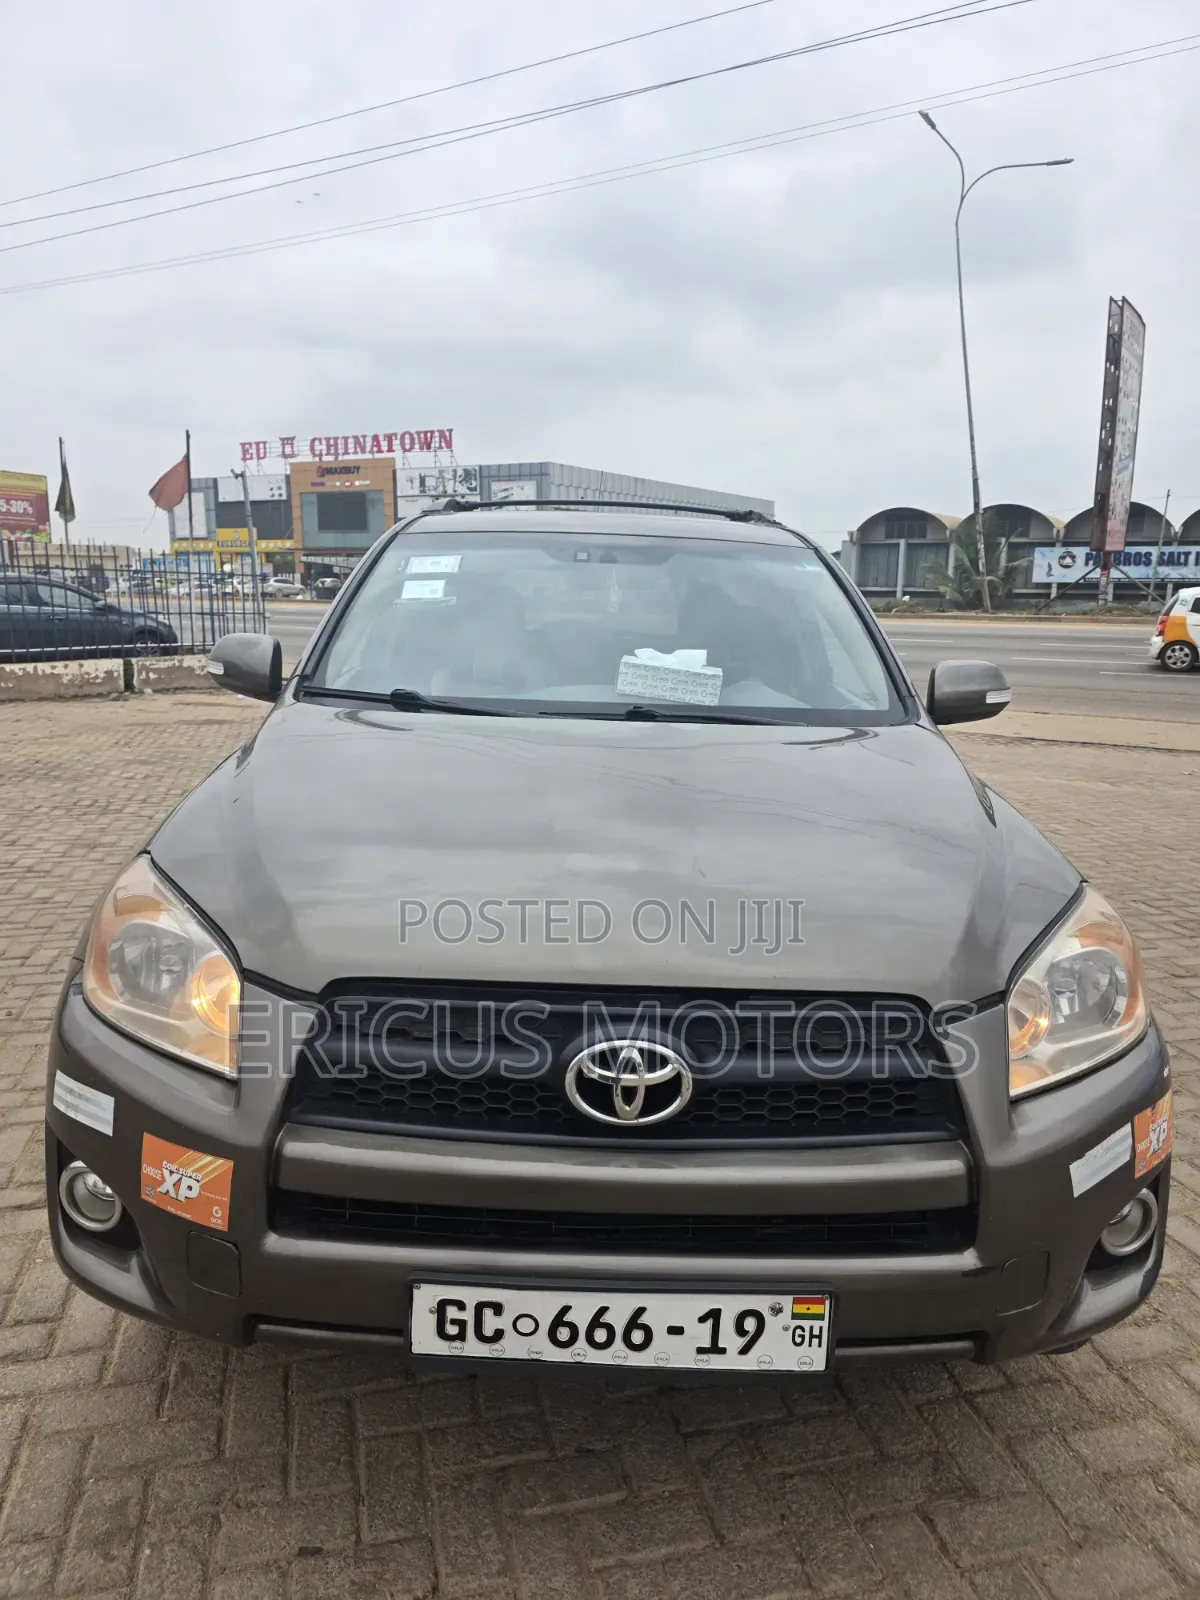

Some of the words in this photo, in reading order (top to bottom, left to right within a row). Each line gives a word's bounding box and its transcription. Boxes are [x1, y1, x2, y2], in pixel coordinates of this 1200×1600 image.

[239, 441, 268, 461] EU
[309, 428, 454, 458] CHINATOWN
[325, 466, 361, 475] MAXBUY
[1084, 552, 1153, 566] PABROS
[1158, 551, 1192, 567] SALT
[142, 1164, 162, 1181] CHOOSE
[179, 1167, 202, 1181] SUPER
[157, 1168, 200, 1203] XP
[791, 1324, 823, 1349] GH
